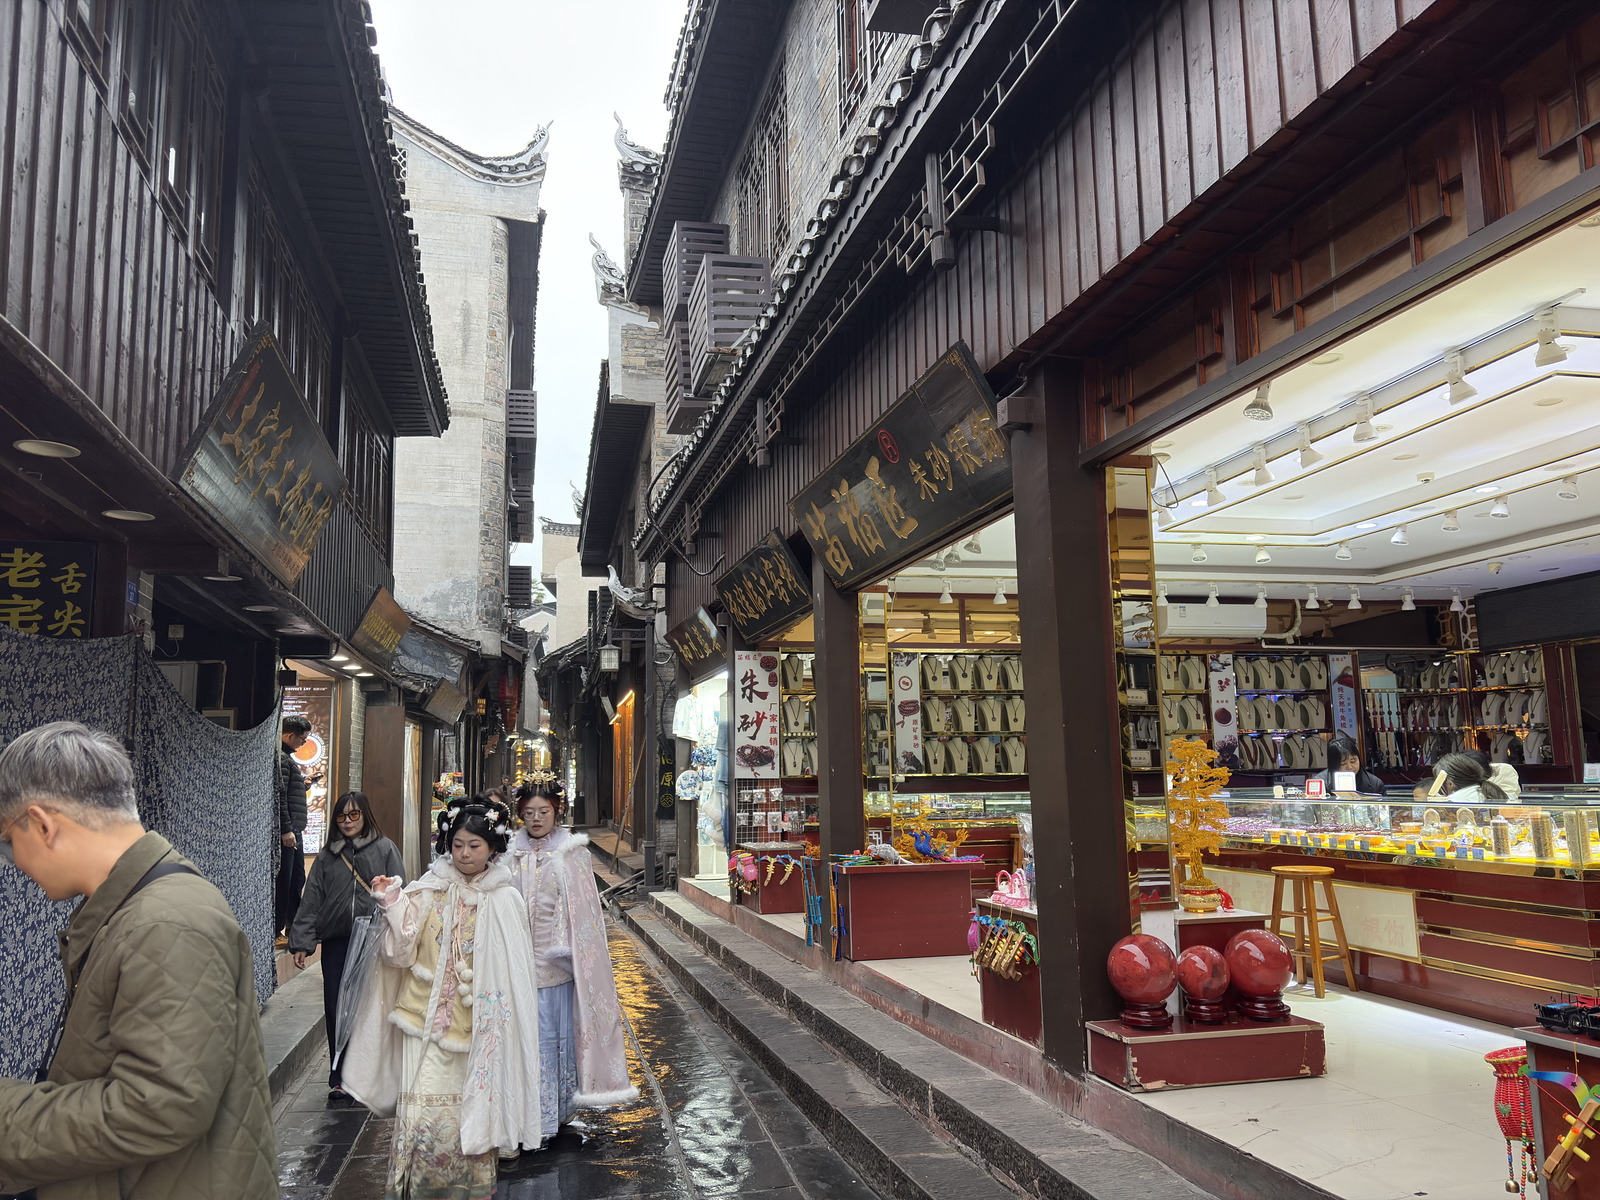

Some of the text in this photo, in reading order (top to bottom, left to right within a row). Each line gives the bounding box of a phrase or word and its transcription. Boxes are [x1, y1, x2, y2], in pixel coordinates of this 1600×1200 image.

[909, 407, 1006, 503] 朱砂银饰
[0, 547, 47, 634] 老宅
[47, 561, 87, 637] 舌尖
[737, 668, 769, 741] 朱砂
[769, 702, 778, 746] 厂家直销
[911, 719, 920, 749] 原矿朱砂
[1337, 686, 1348, 729] 纯天然牛角梳
